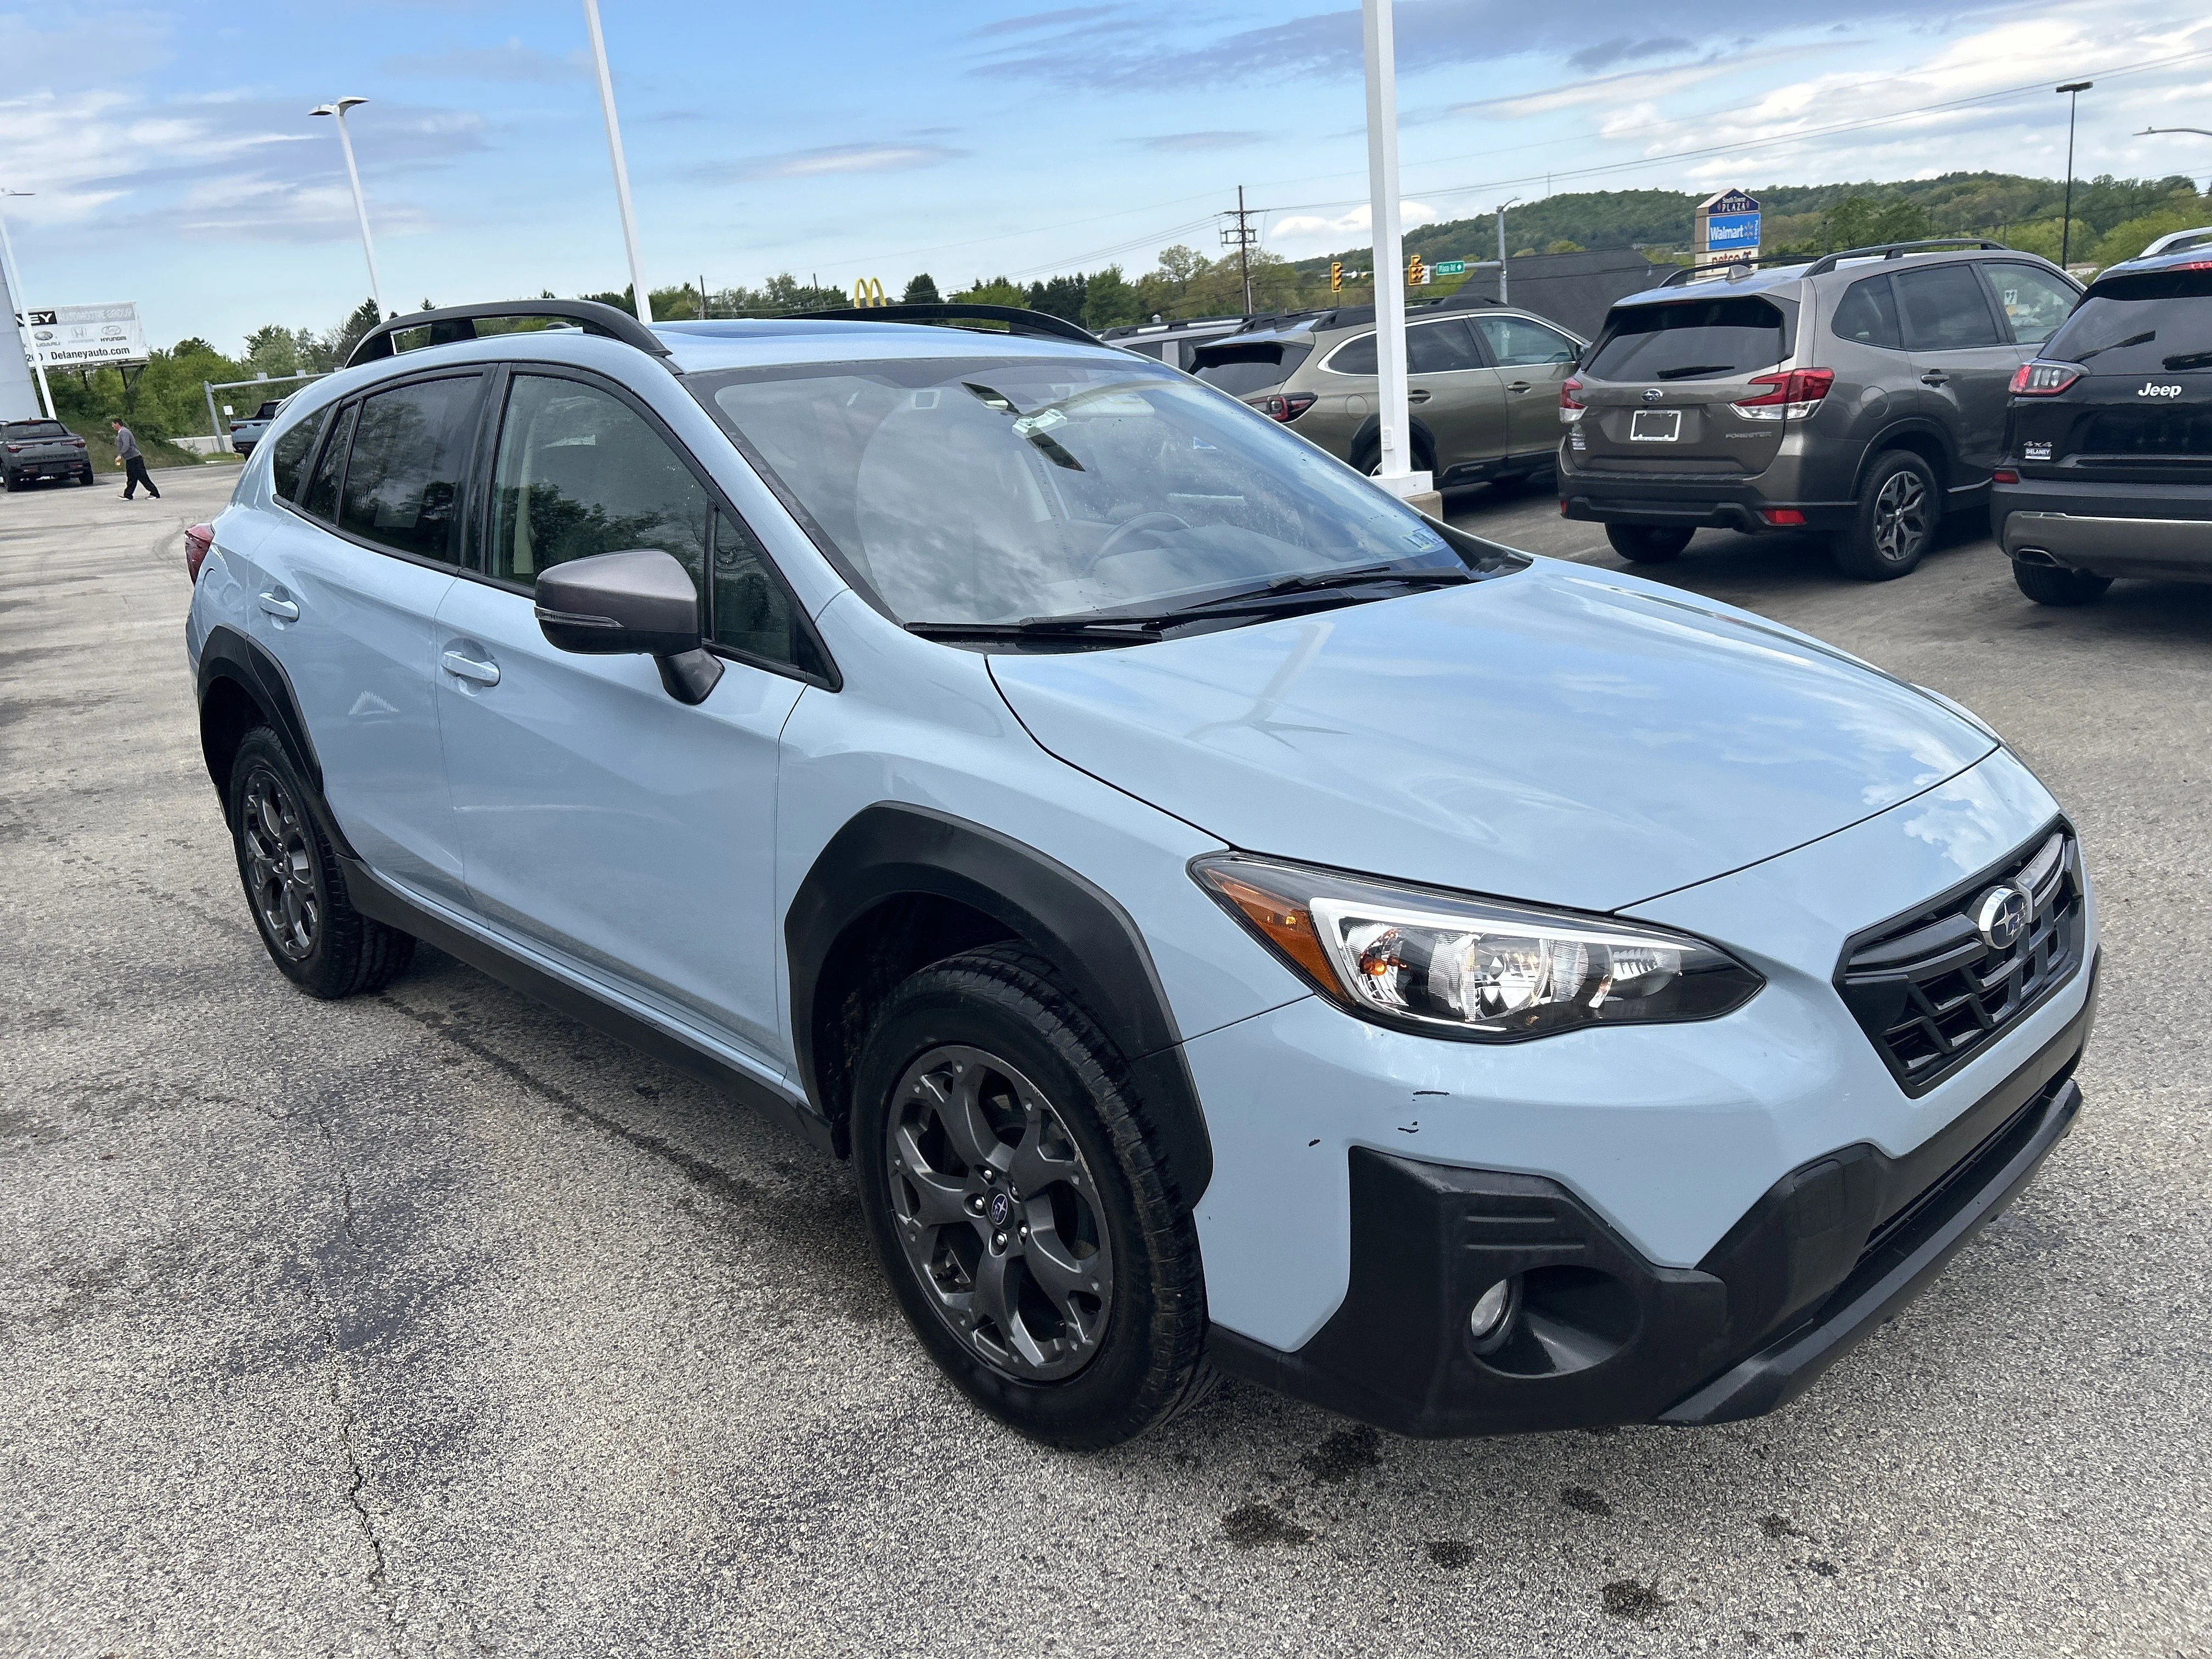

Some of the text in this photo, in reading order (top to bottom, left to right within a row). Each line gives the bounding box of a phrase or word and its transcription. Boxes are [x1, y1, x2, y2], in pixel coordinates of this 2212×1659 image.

[1722, 202, 1746, 212] PLAZA
[1710, 224, 1743, 241] Walmart
[50, 347, 129, 360] Delaneyauto.com
[2137, 382, 2182, 399] Jeep
